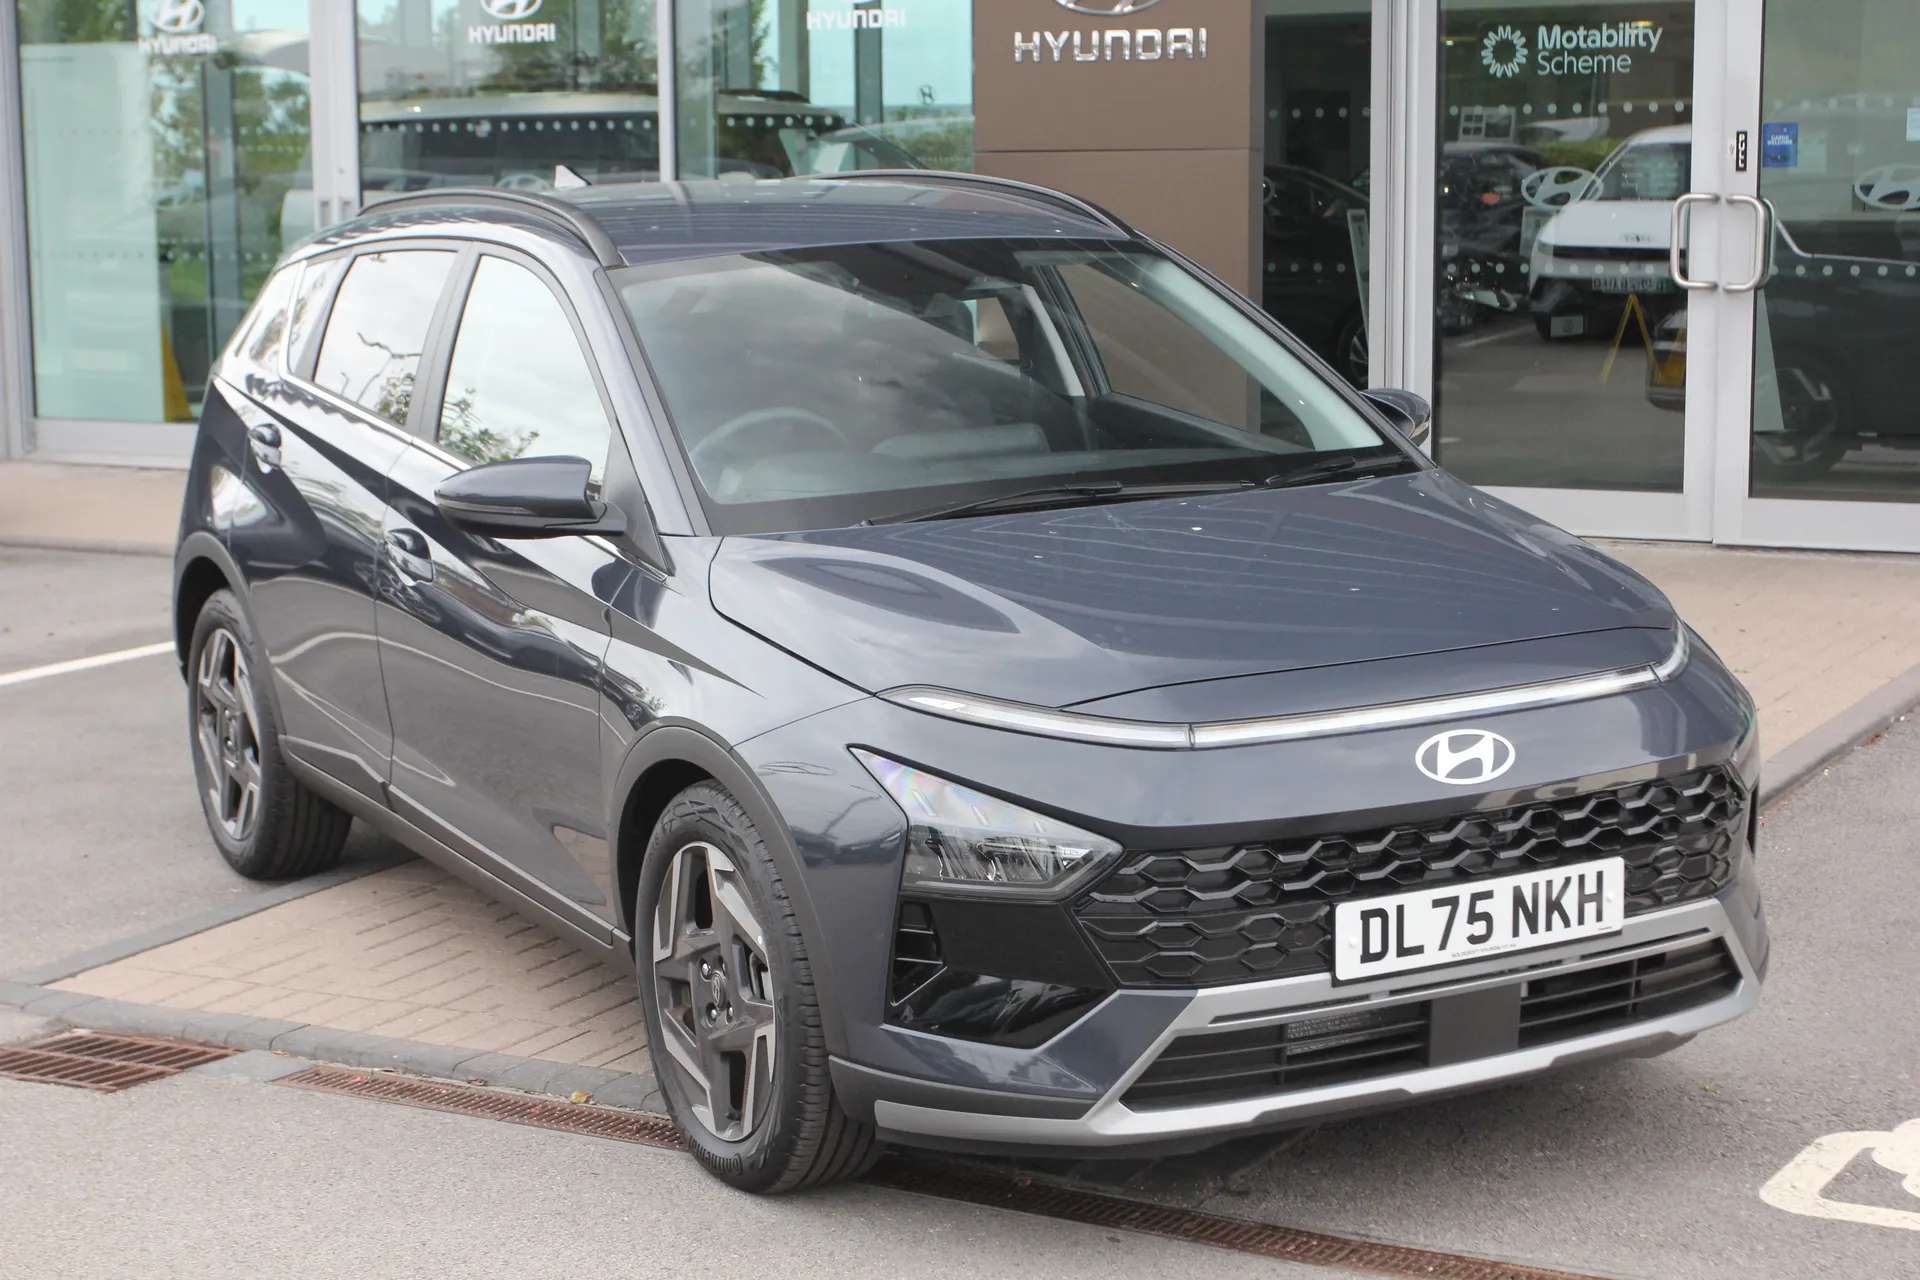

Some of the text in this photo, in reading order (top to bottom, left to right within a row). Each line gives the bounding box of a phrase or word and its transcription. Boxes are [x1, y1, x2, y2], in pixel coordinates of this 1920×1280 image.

[806, 8, 906, 30] HYUNDAI
[138, 34, 218, 55] HYUNDAI
[468, 23, 556, 43] HYUNDAI
[1014, 27, 1207, 62] HYUNDAI
[1537, 21, 1663, 53] Motability
[1537, 51, 1632, 76] Scheme
[1512, 870, 1604, 938] NKH
